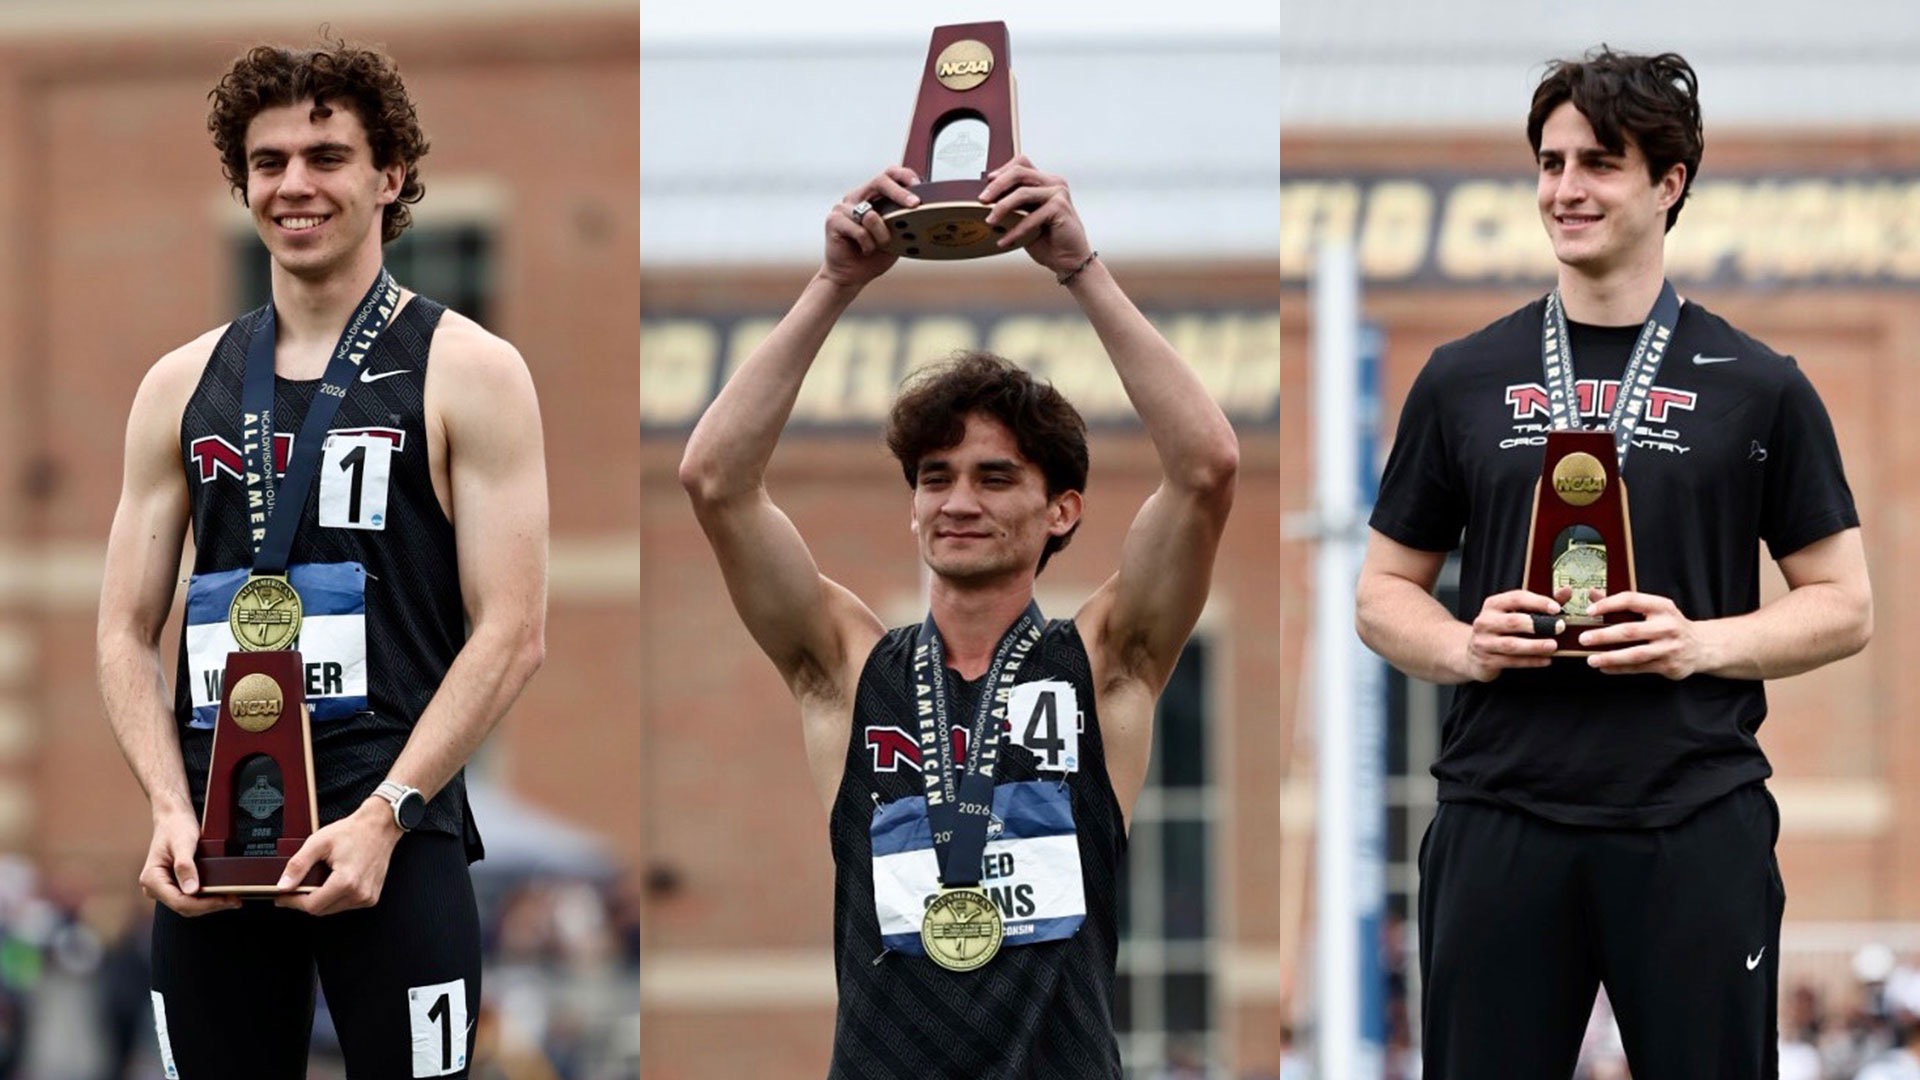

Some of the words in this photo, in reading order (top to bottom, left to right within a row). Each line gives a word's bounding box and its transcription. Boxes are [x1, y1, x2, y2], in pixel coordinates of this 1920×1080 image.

[939, 60, 989, 77] NCAA
[337, 336, 355, 360] NCAA
[349, 299, 377, 335] DIVISION
[349, 275, 400, 366] ALL-AME
[1642, 319, 1656, 341] FIELD
[320, 383, 346, 398] 2026
[261, 410, 270, 436] NCAA
[262, 436, 272, 479] DIVISION
[1500, 436, 1548, 449] CRO
[1631, 440, 1691, 454] NTRY
[244, 413, 266, 553] ALL-AMER
[339, 446, 366, 523] 1
[1557, 476, 1605, 492] NCAA
[1011, 615, 1031, 636] FIELD
[982, 658, 1003, 700] OUTDOOR
[233, 700, 280, 716] NCAA
[978, 625, 1042, 778] ALL-AMERICAN
[914, 645, 943, 805] ALL-AMERICAN
[936, 699, 948, 742] OUTDOOR
[972, 710, 988, 749] DIVISION
[1023, 691, 1065, 766] 4
[940, 741, 951, 771] TRACK
[967, 749, 979, 776] NCAA
[944, 778, 956, 803] FIELD
[958, 802, 990, 816] 2026
[934, 831, 953, 844] 20
[427, 993, 452, 1070] 1
